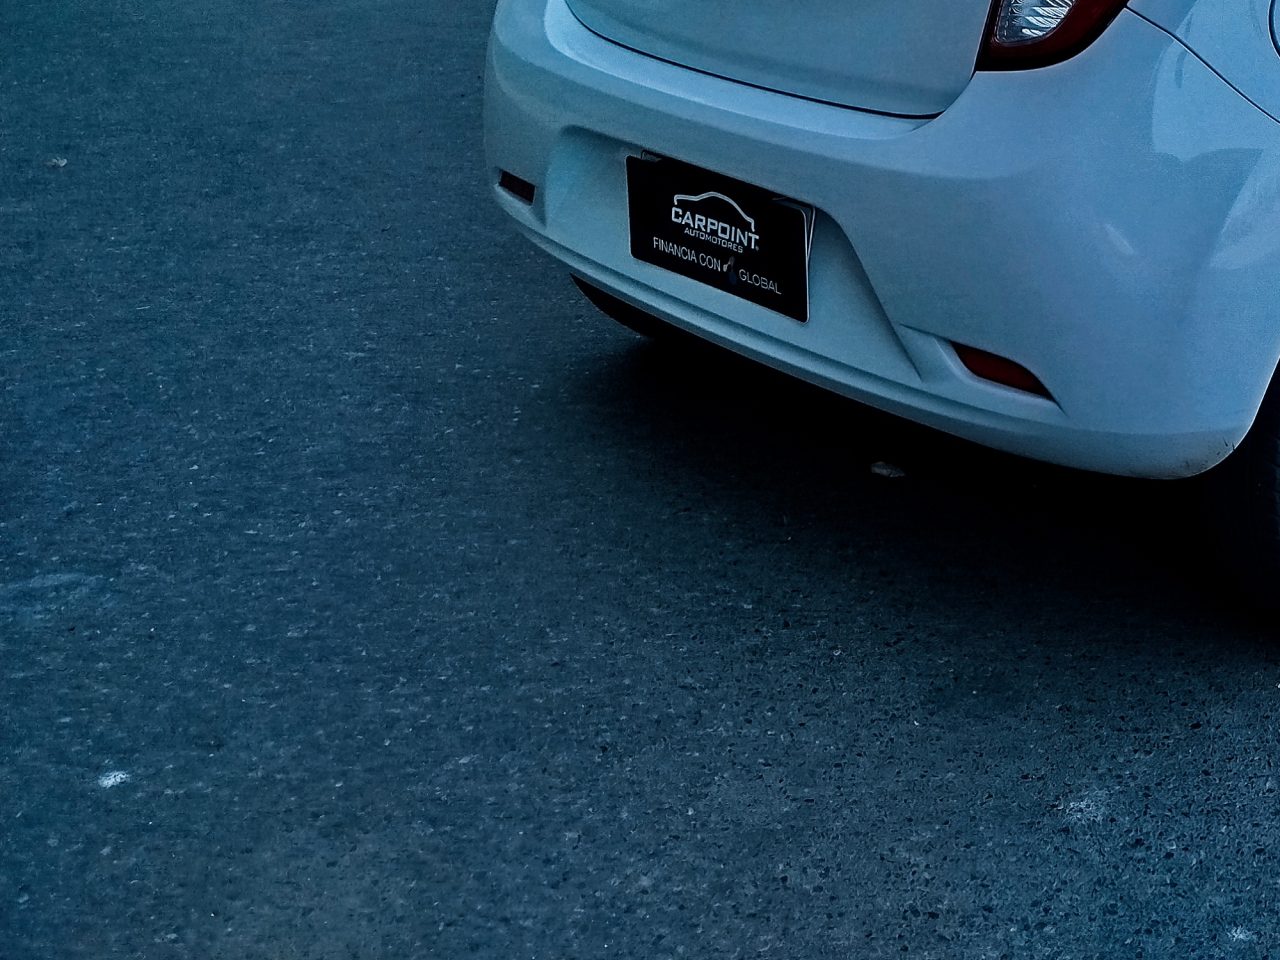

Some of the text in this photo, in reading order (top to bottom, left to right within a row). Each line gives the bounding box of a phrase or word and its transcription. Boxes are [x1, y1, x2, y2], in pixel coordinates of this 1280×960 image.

[671, 206, 759, 250] CARPOINT
[684, 227, 743, 253] AUTOMOTORES
[653, 236, 782, 294] FINANCIA CON GLOBAL
